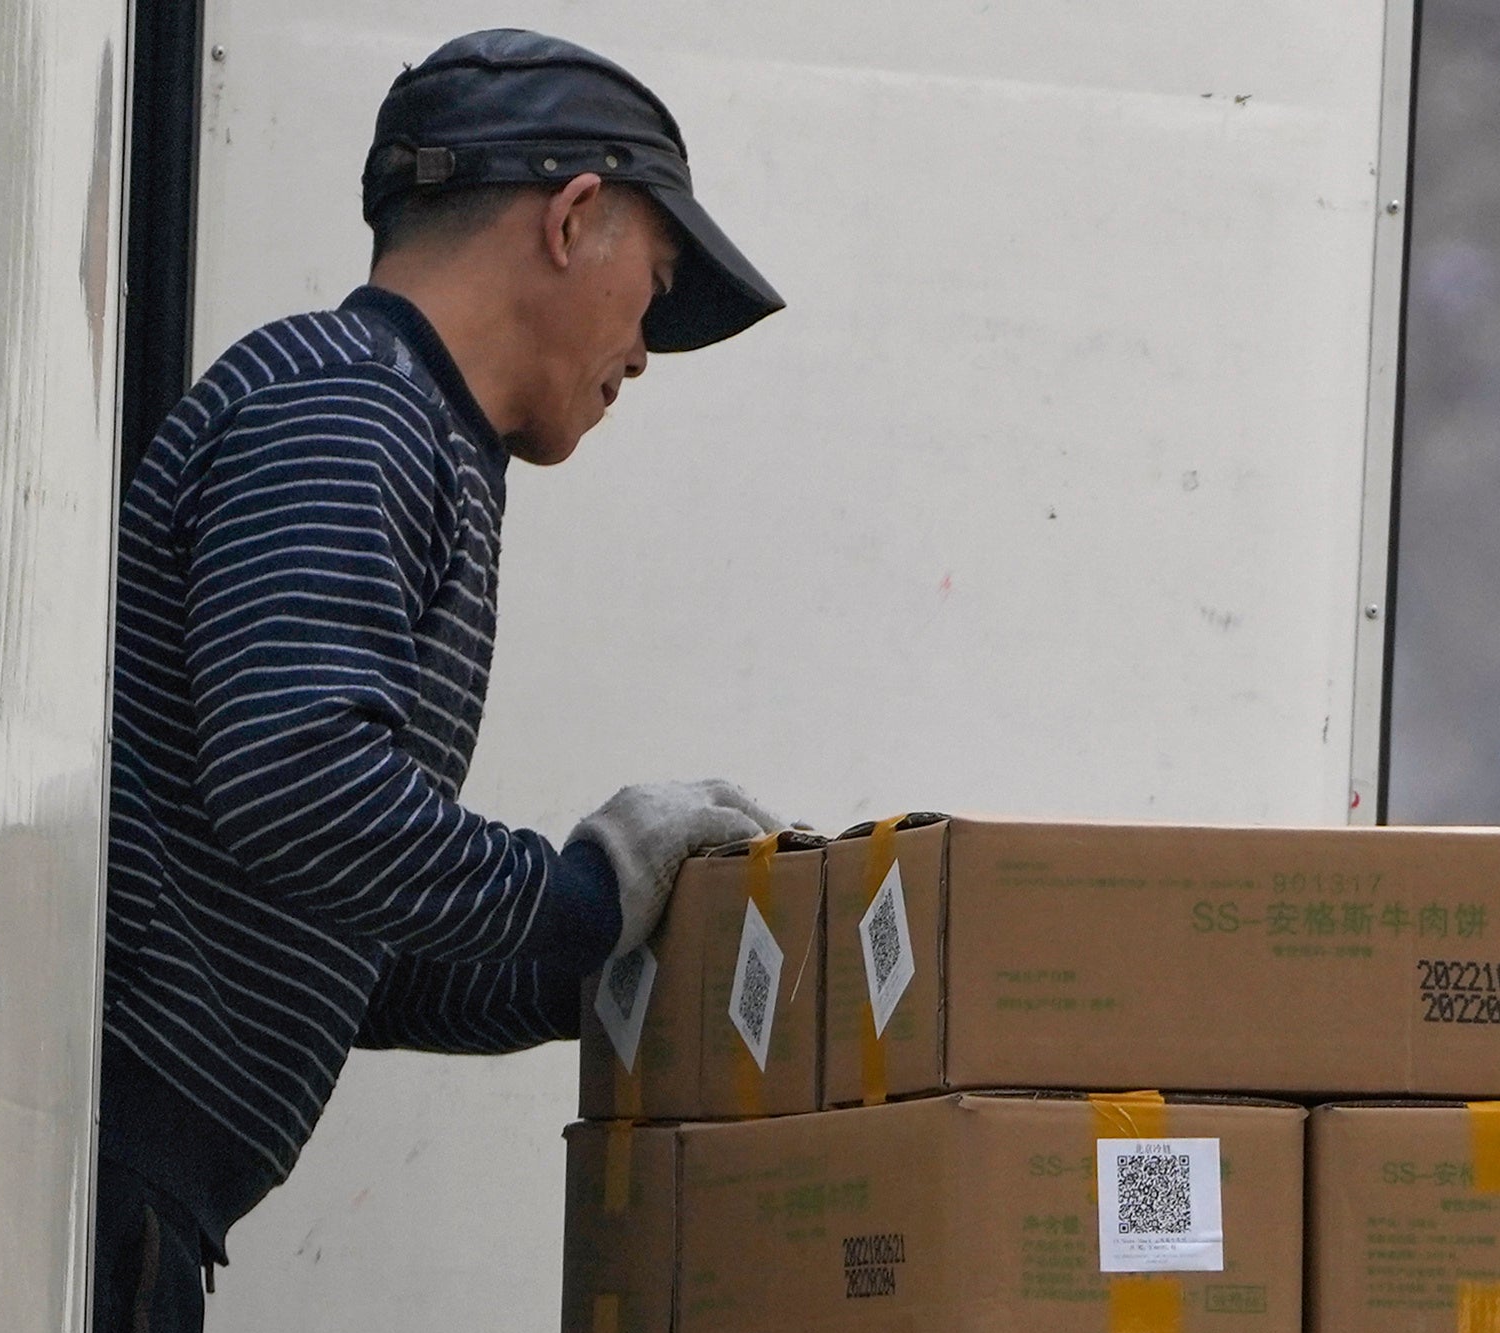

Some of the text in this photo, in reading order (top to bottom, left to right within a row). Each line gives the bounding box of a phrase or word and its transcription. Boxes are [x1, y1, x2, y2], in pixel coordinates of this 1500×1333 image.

[1190, 901, 1489, 940] SS-安格斯牛肉饼
